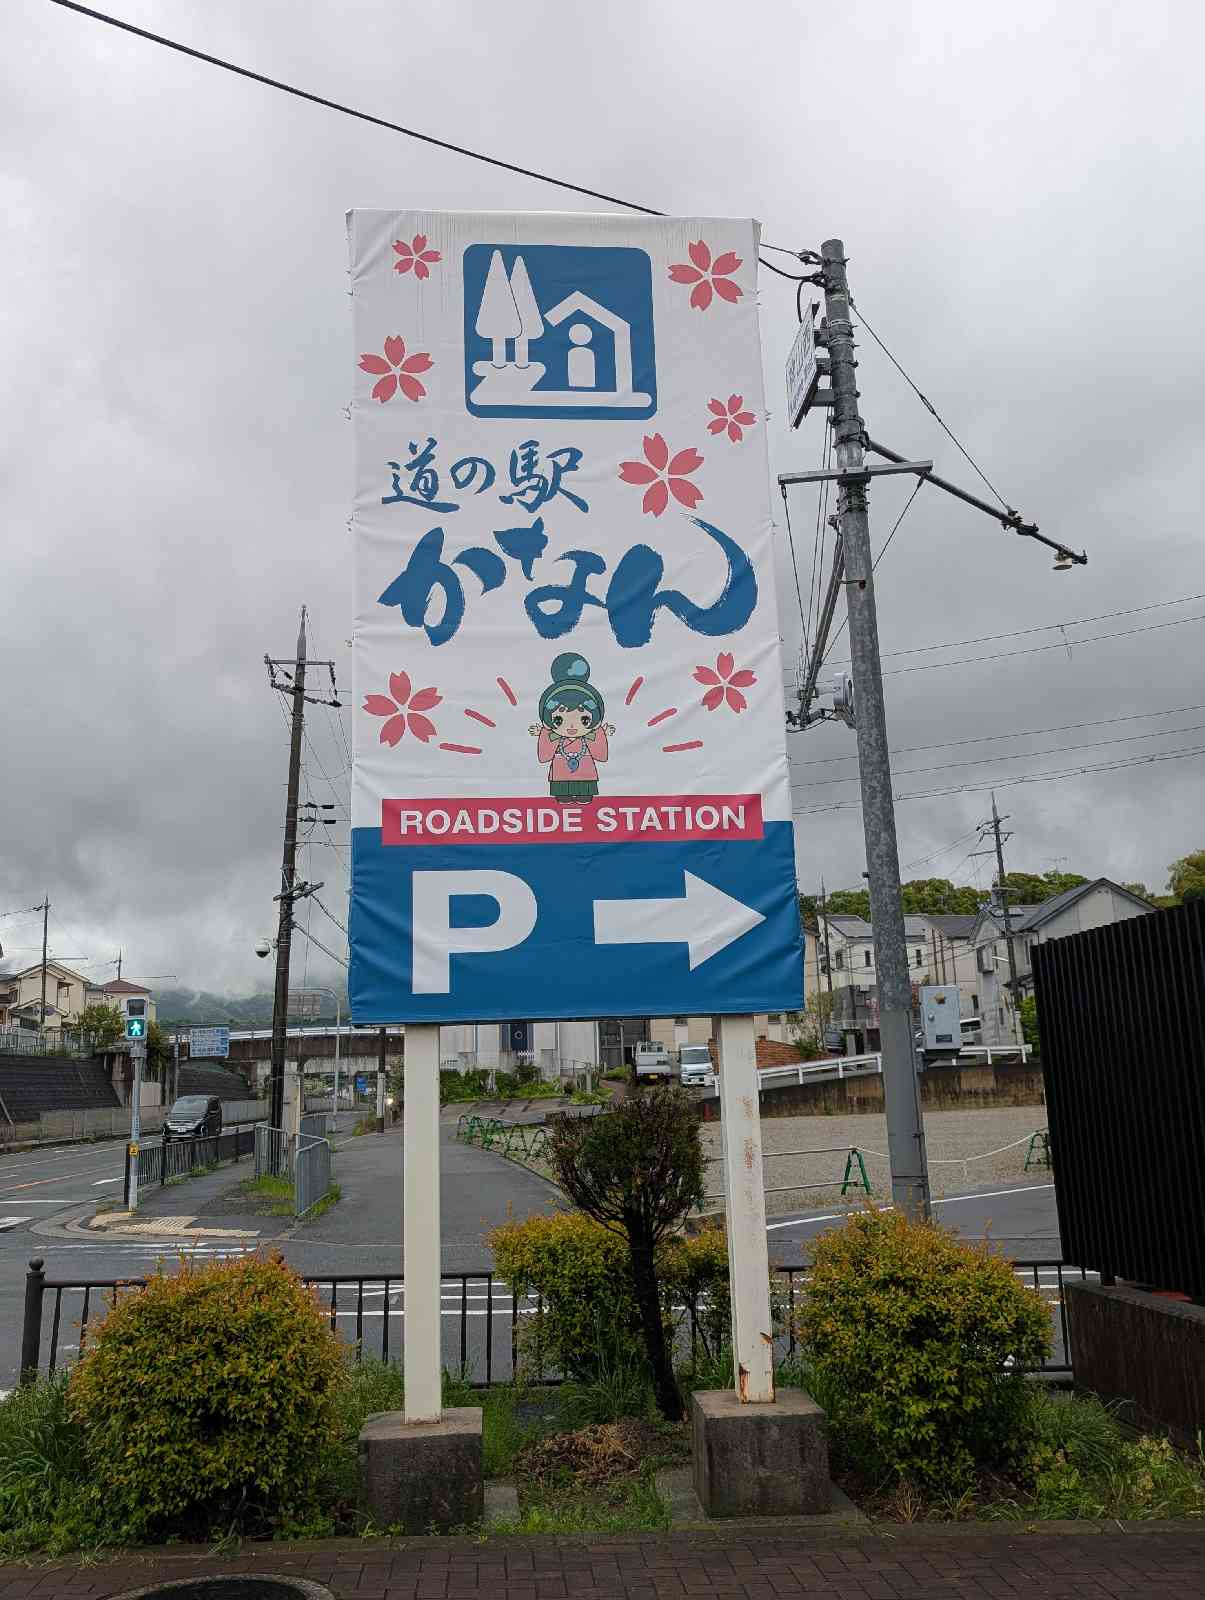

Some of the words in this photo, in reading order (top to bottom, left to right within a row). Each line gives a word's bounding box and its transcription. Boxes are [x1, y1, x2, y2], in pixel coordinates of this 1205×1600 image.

[381, 436, 590, 514] 道の駅
[377, 512, 759, 648] かなん
[399, 807, 584, 835] ROADSIDE
[596, 804, 746, 832] STATION
[411, 868, 538, 995] P
